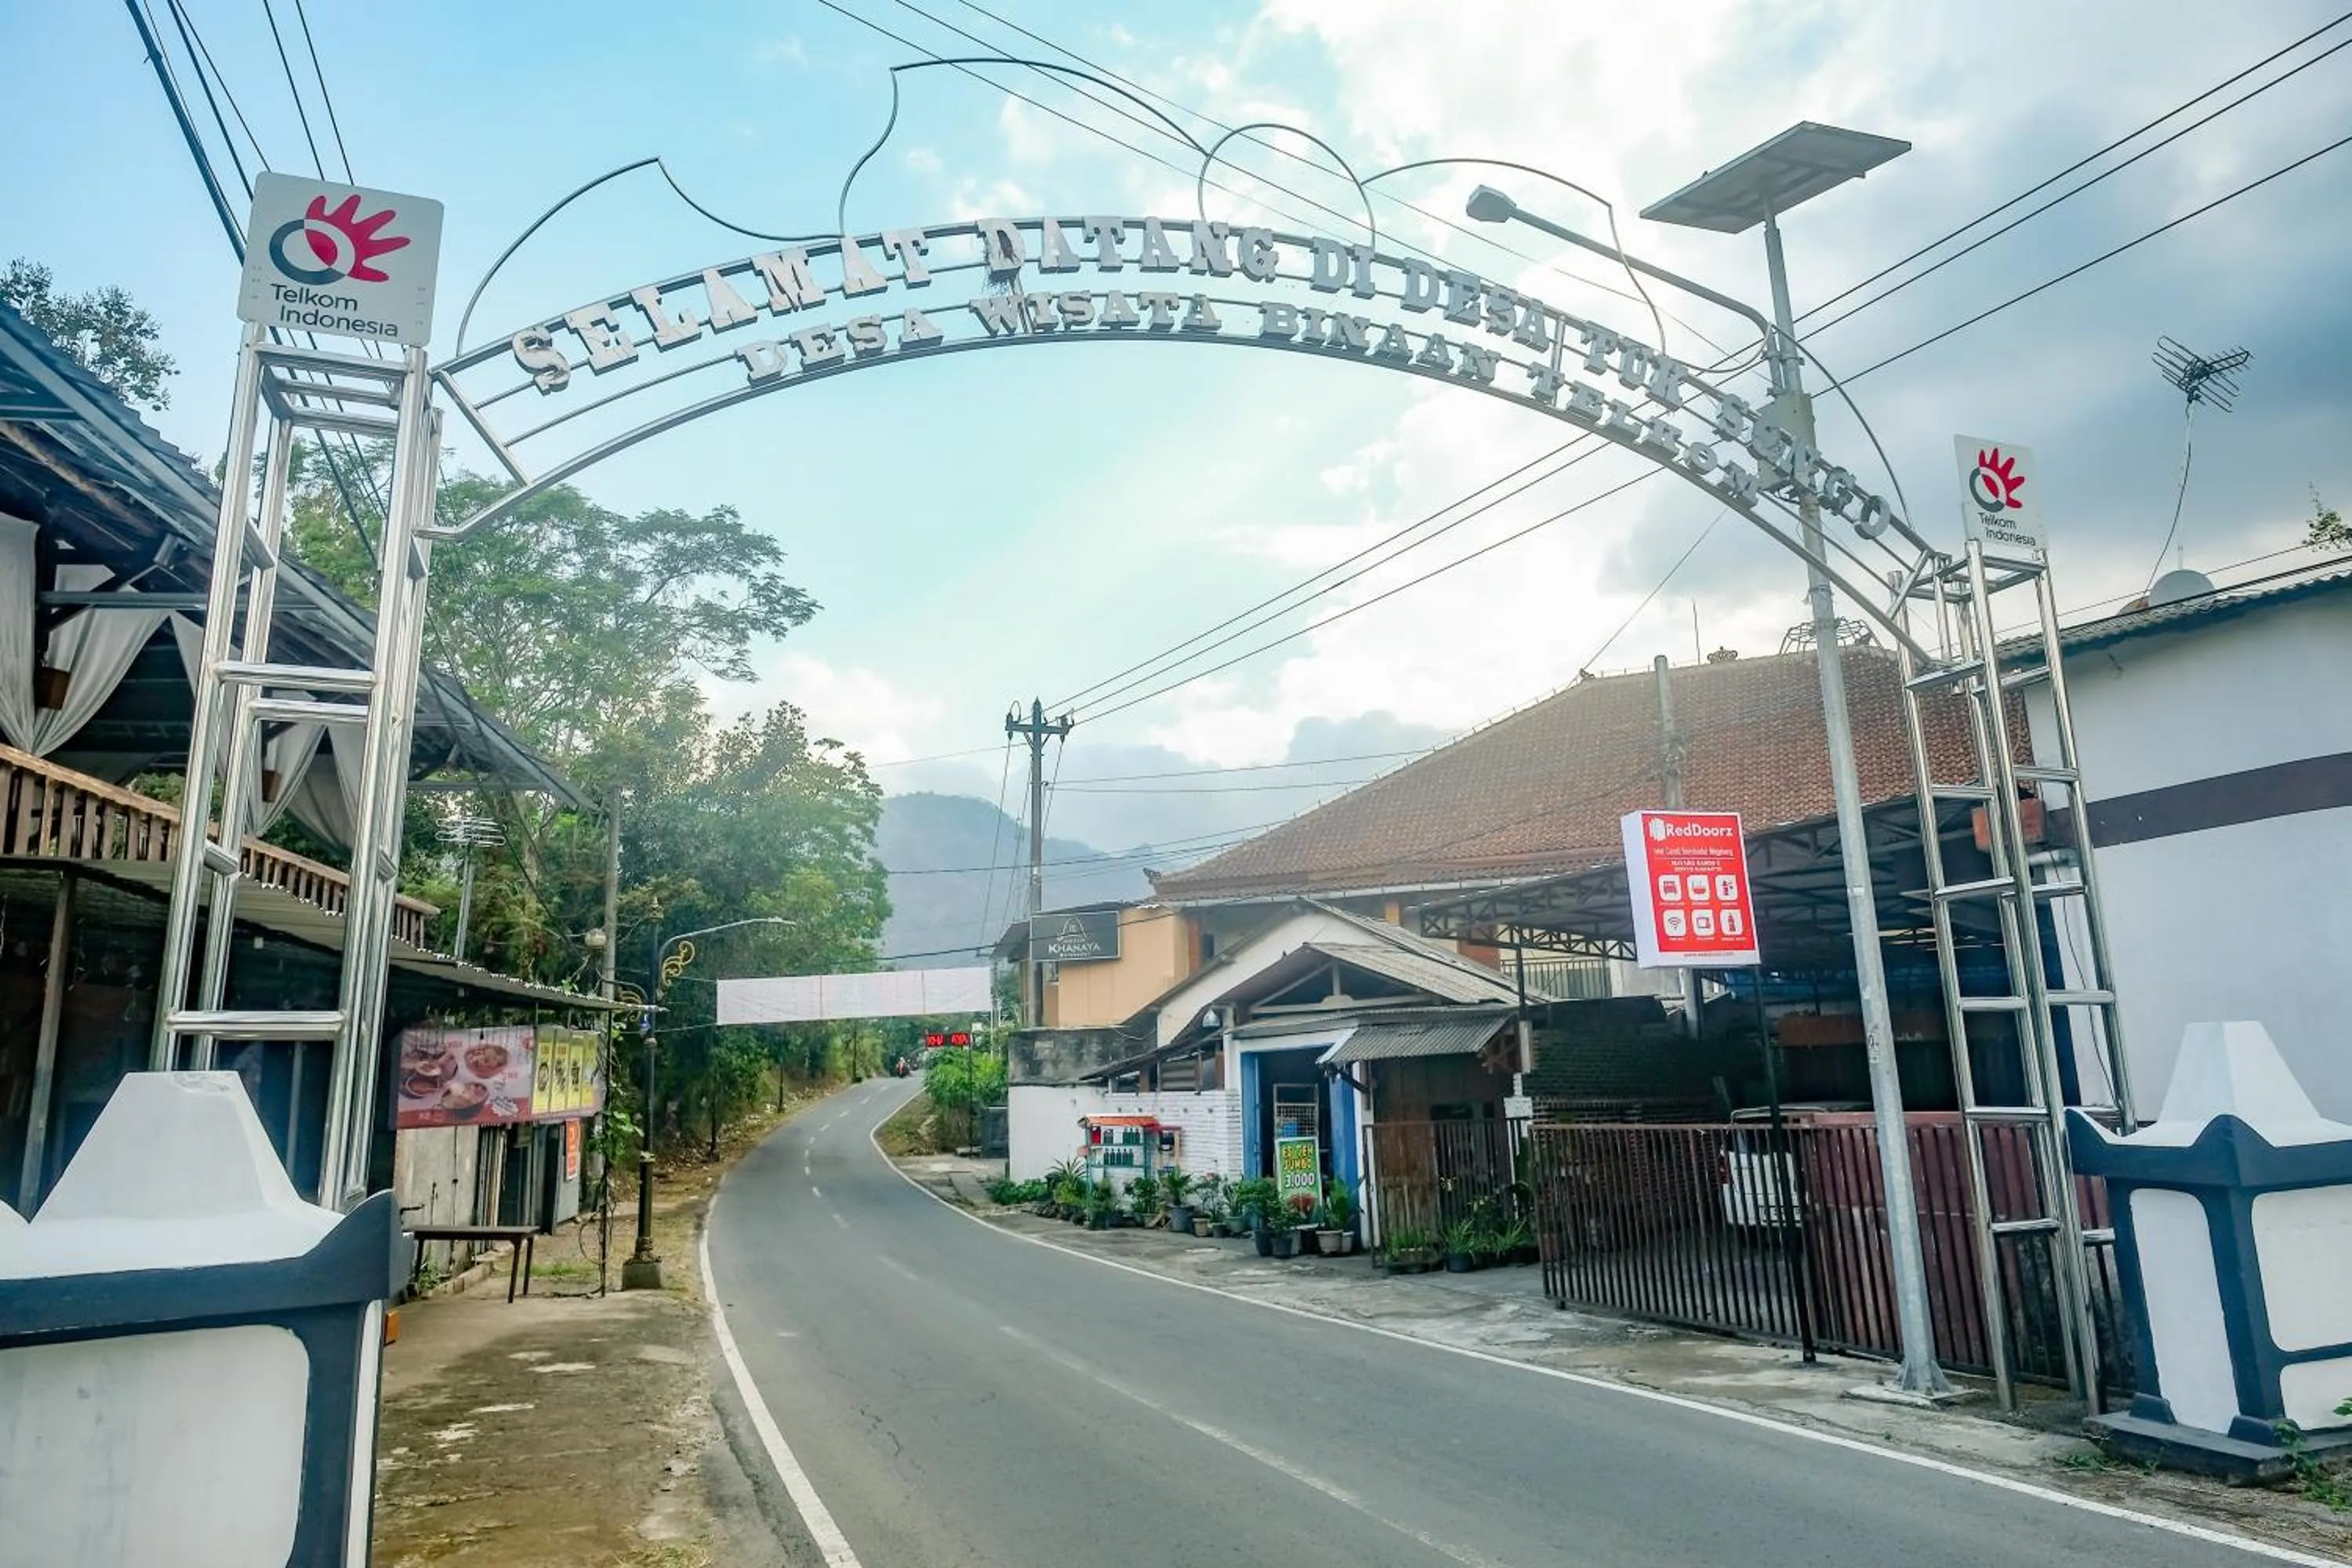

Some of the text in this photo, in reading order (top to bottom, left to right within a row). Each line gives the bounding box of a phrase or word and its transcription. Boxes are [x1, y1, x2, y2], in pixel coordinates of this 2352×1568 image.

[270, 283, 358, 311] Telkom
[512, 227, 931, 395] SELAMAT
[975, 216, 1278, 282] DATANG
[1310, 236, 1375, 299] DI
[1400, 257, 1549, 352] DESA
[280, 305, 398, 337] Indonesia
[735, 290, 1759, 510] DESA WISATA BINAAN TELKOM
[1978, 512, 2017, 529] Telkom
[1985, 527, 2036, 546] Indonesia
[1666, 822, 1733, 837] RedDoorz
[1048, 942, 1101, 954] KHANAYA
